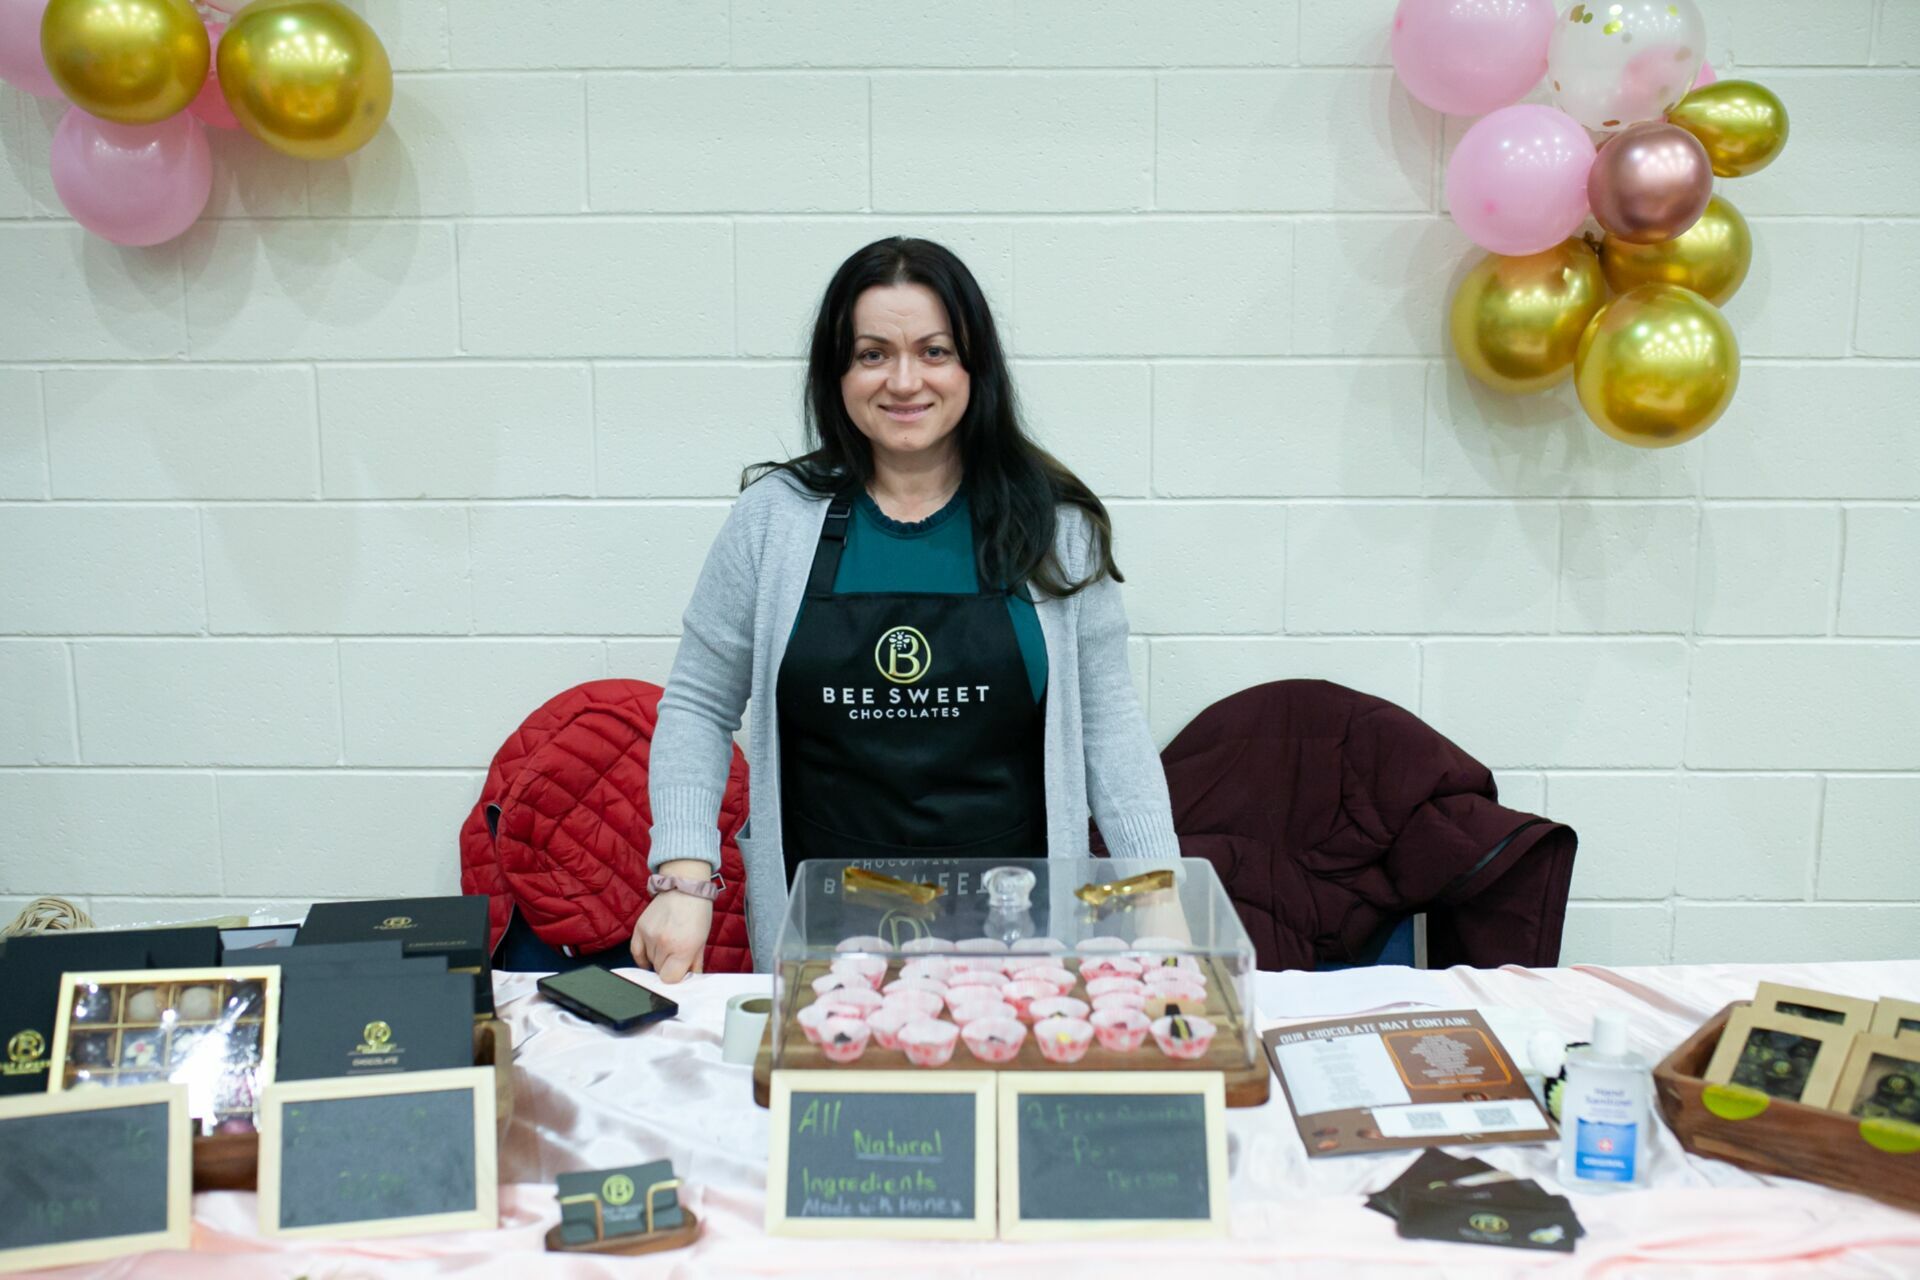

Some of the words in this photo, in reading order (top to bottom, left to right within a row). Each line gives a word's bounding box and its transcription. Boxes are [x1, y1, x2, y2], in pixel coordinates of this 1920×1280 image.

[822, 686, 875, 705] BEE
[888, 685, 990, 705] SWEET
[848, 706, 961, 720] CHOCOLATES
[1280, 1032, 1306, 1046] OUR
[1307, 1022, 1377, 1041] CHOCOLATE
[1378, 1017, 1410, 1032] MAY
[798, 1098, 842, 1137] All
[853, 1127, 943, 1156] Natural
[802, 1166, 937, 1201] Ingredients
[801, 1195, 851, 1217] Made
